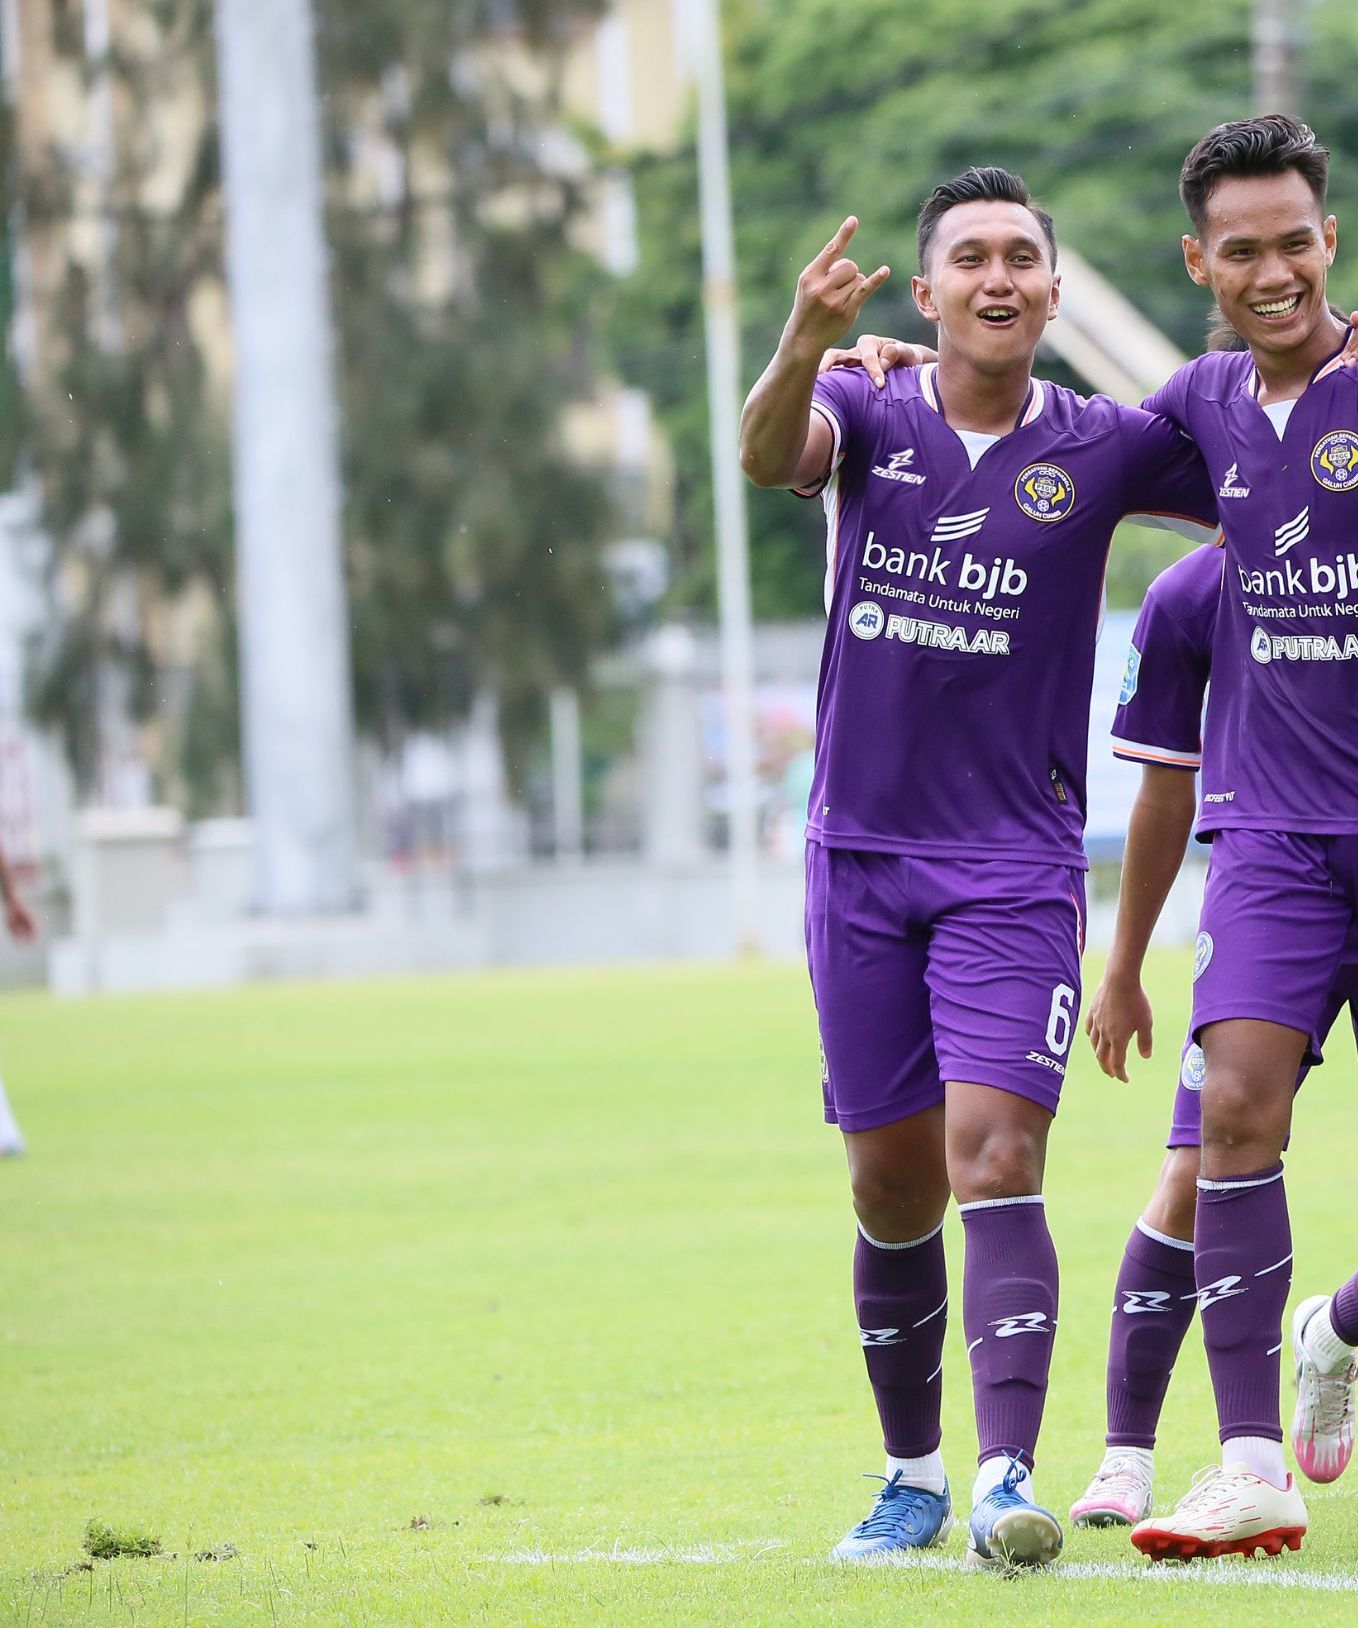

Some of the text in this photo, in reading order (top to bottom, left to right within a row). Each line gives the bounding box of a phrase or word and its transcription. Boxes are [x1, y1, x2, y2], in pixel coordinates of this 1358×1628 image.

[872, 465, 927, 486] ZESTIEN
[862, 531, 1028, 600] bank bjb
[1238, 559, 1307, 596] bank
[859, 576, 1020, 620] Tandamata Untuk Negeri
[1242, 601, 1297, 619] Tandamata
[856, 613, 879, 629] AR
[1044, 983, 1076, 1057] 6
